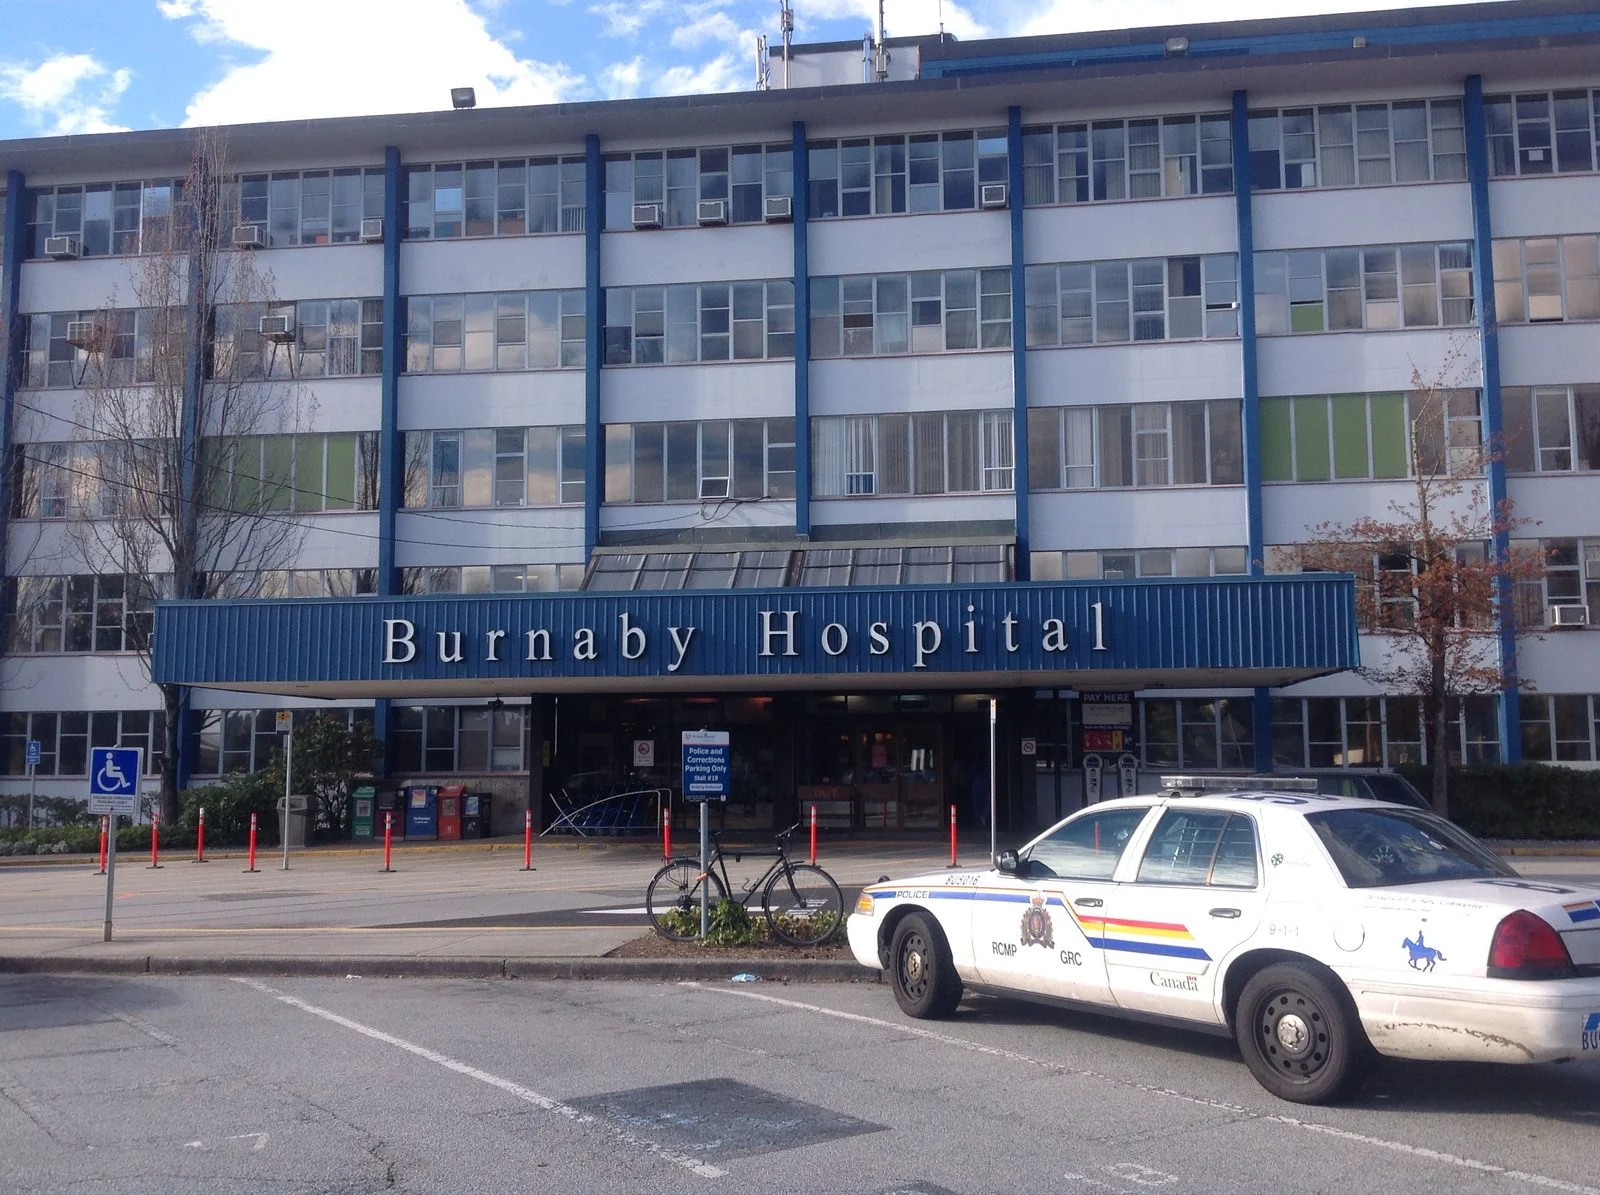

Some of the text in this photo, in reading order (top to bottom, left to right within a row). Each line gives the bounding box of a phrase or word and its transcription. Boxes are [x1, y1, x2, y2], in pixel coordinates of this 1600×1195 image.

[382, 602, 1107, 672] Burnaby Hospital
[1083, 693, 1130, 702] PAY HERE
[689, 747, 723, 755] Police and
[687, 756, 725, 764] Corrections
[685, 765, 727, 773] Parking Only
[896, 890, 928, 899] POLICE
[1269, 923, 1299, 937] 9-1-1
[992, 941, 1017, 957] RCMP
[1060, 950, 1082, 966] GRC
[1150, 971, 1199, 992] Canada
[1582, 1031, 1600, 1051] BU
